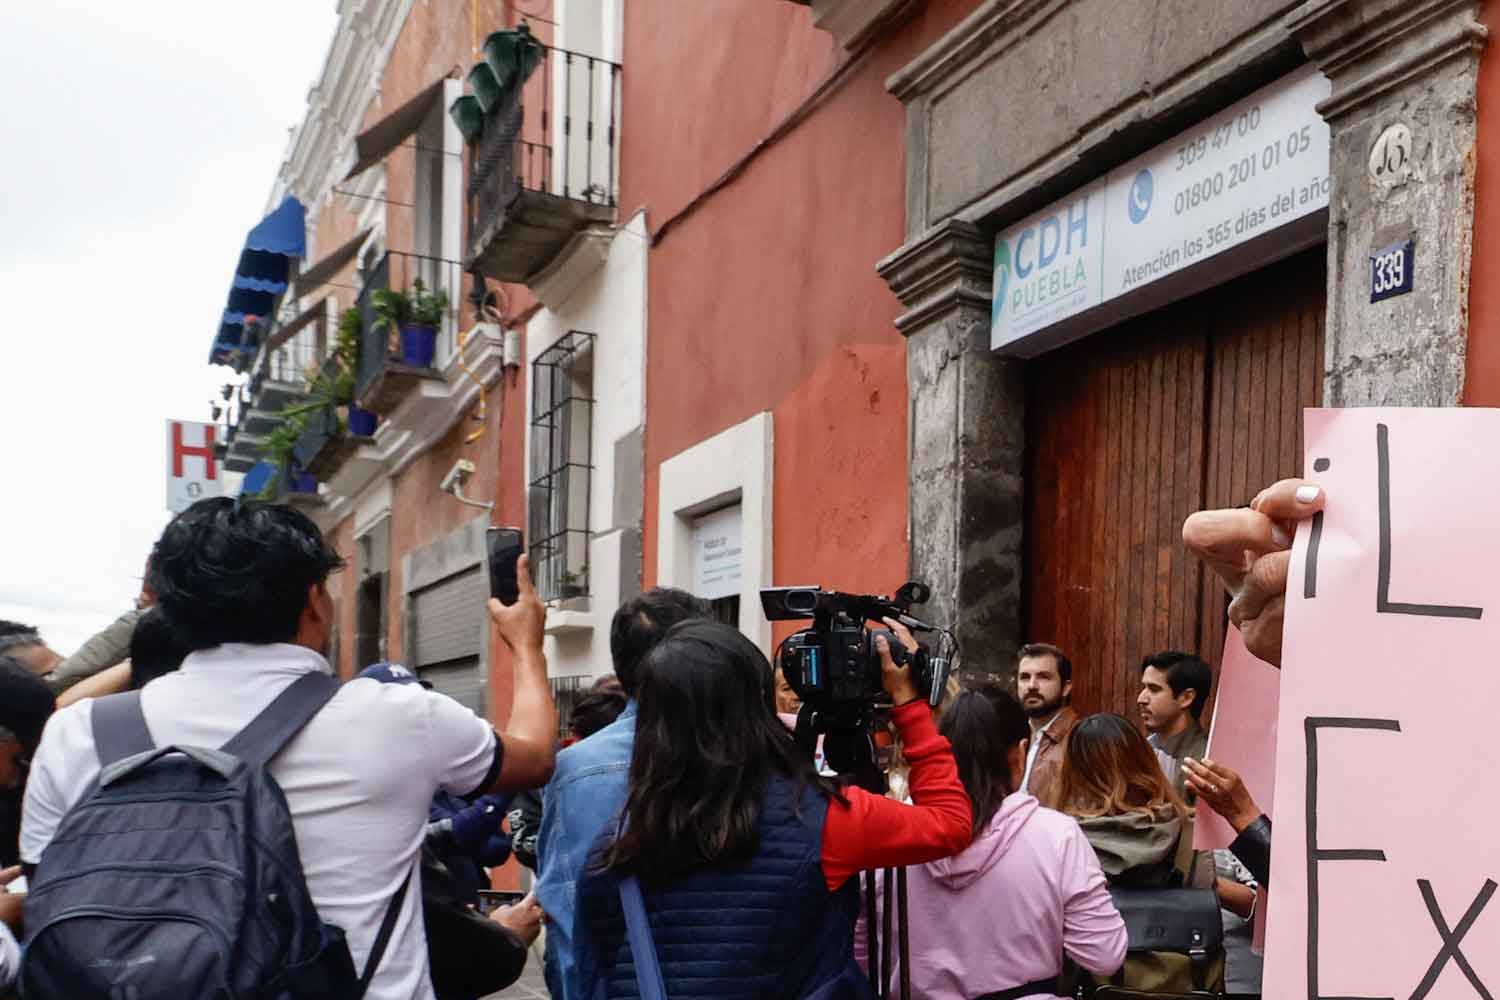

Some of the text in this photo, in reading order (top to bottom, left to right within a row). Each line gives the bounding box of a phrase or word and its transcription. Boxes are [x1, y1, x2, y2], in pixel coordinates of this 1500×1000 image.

[1174, 125, 1312, 216] 01800 201 01 05
[1175, 105, 1261, 171] 309 47 00
[1015, 196, 1089, 279] CDH
[1121, 174, 1332, 289] Atención los 365 días del año
[1012, 255, 1087, 314] PUEBLA
[1374, 249, 1404, 294] 339
[172, 421, 216, 480] H
